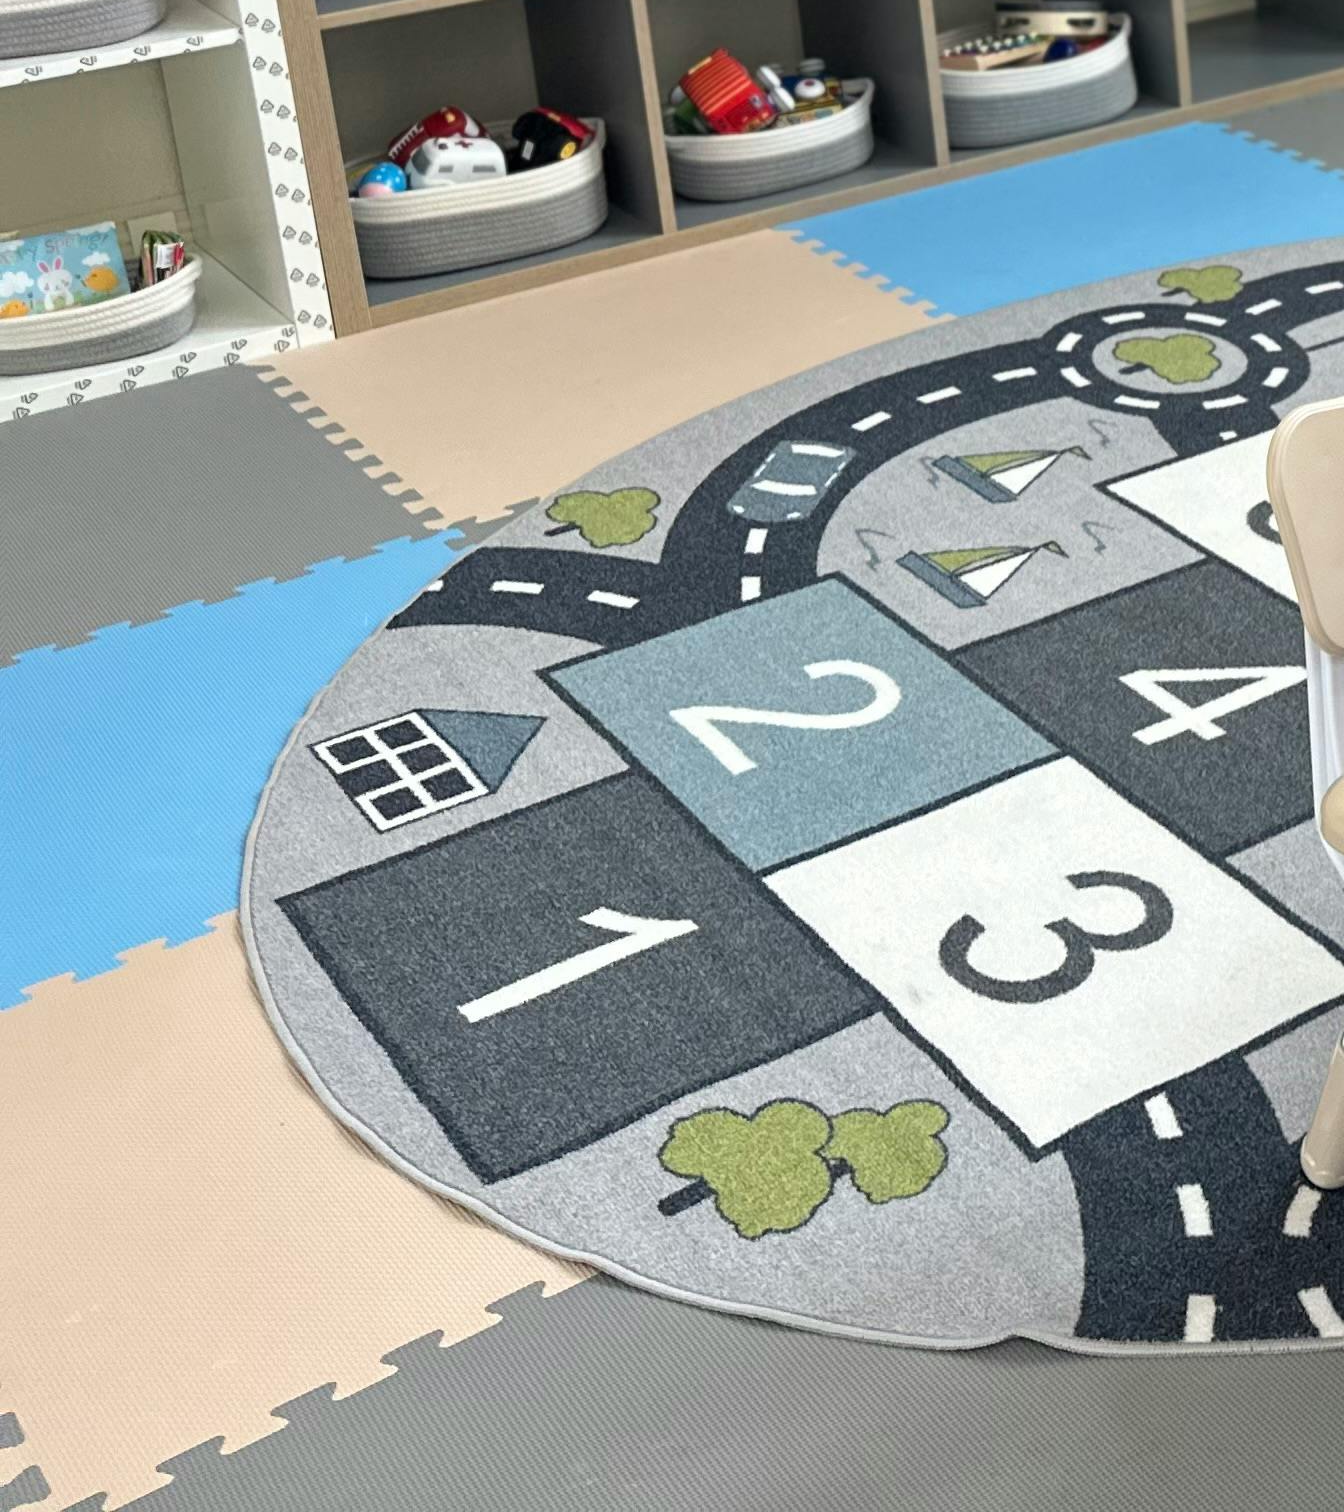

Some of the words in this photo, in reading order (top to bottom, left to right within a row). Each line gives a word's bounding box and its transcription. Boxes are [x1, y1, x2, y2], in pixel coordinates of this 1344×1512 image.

[668, 660, 903, 776] 2
[1117, 665, 1308, 751] 4
[456, 905, 702, 1024] 1
[937, 870, 1177, 1006] 3
